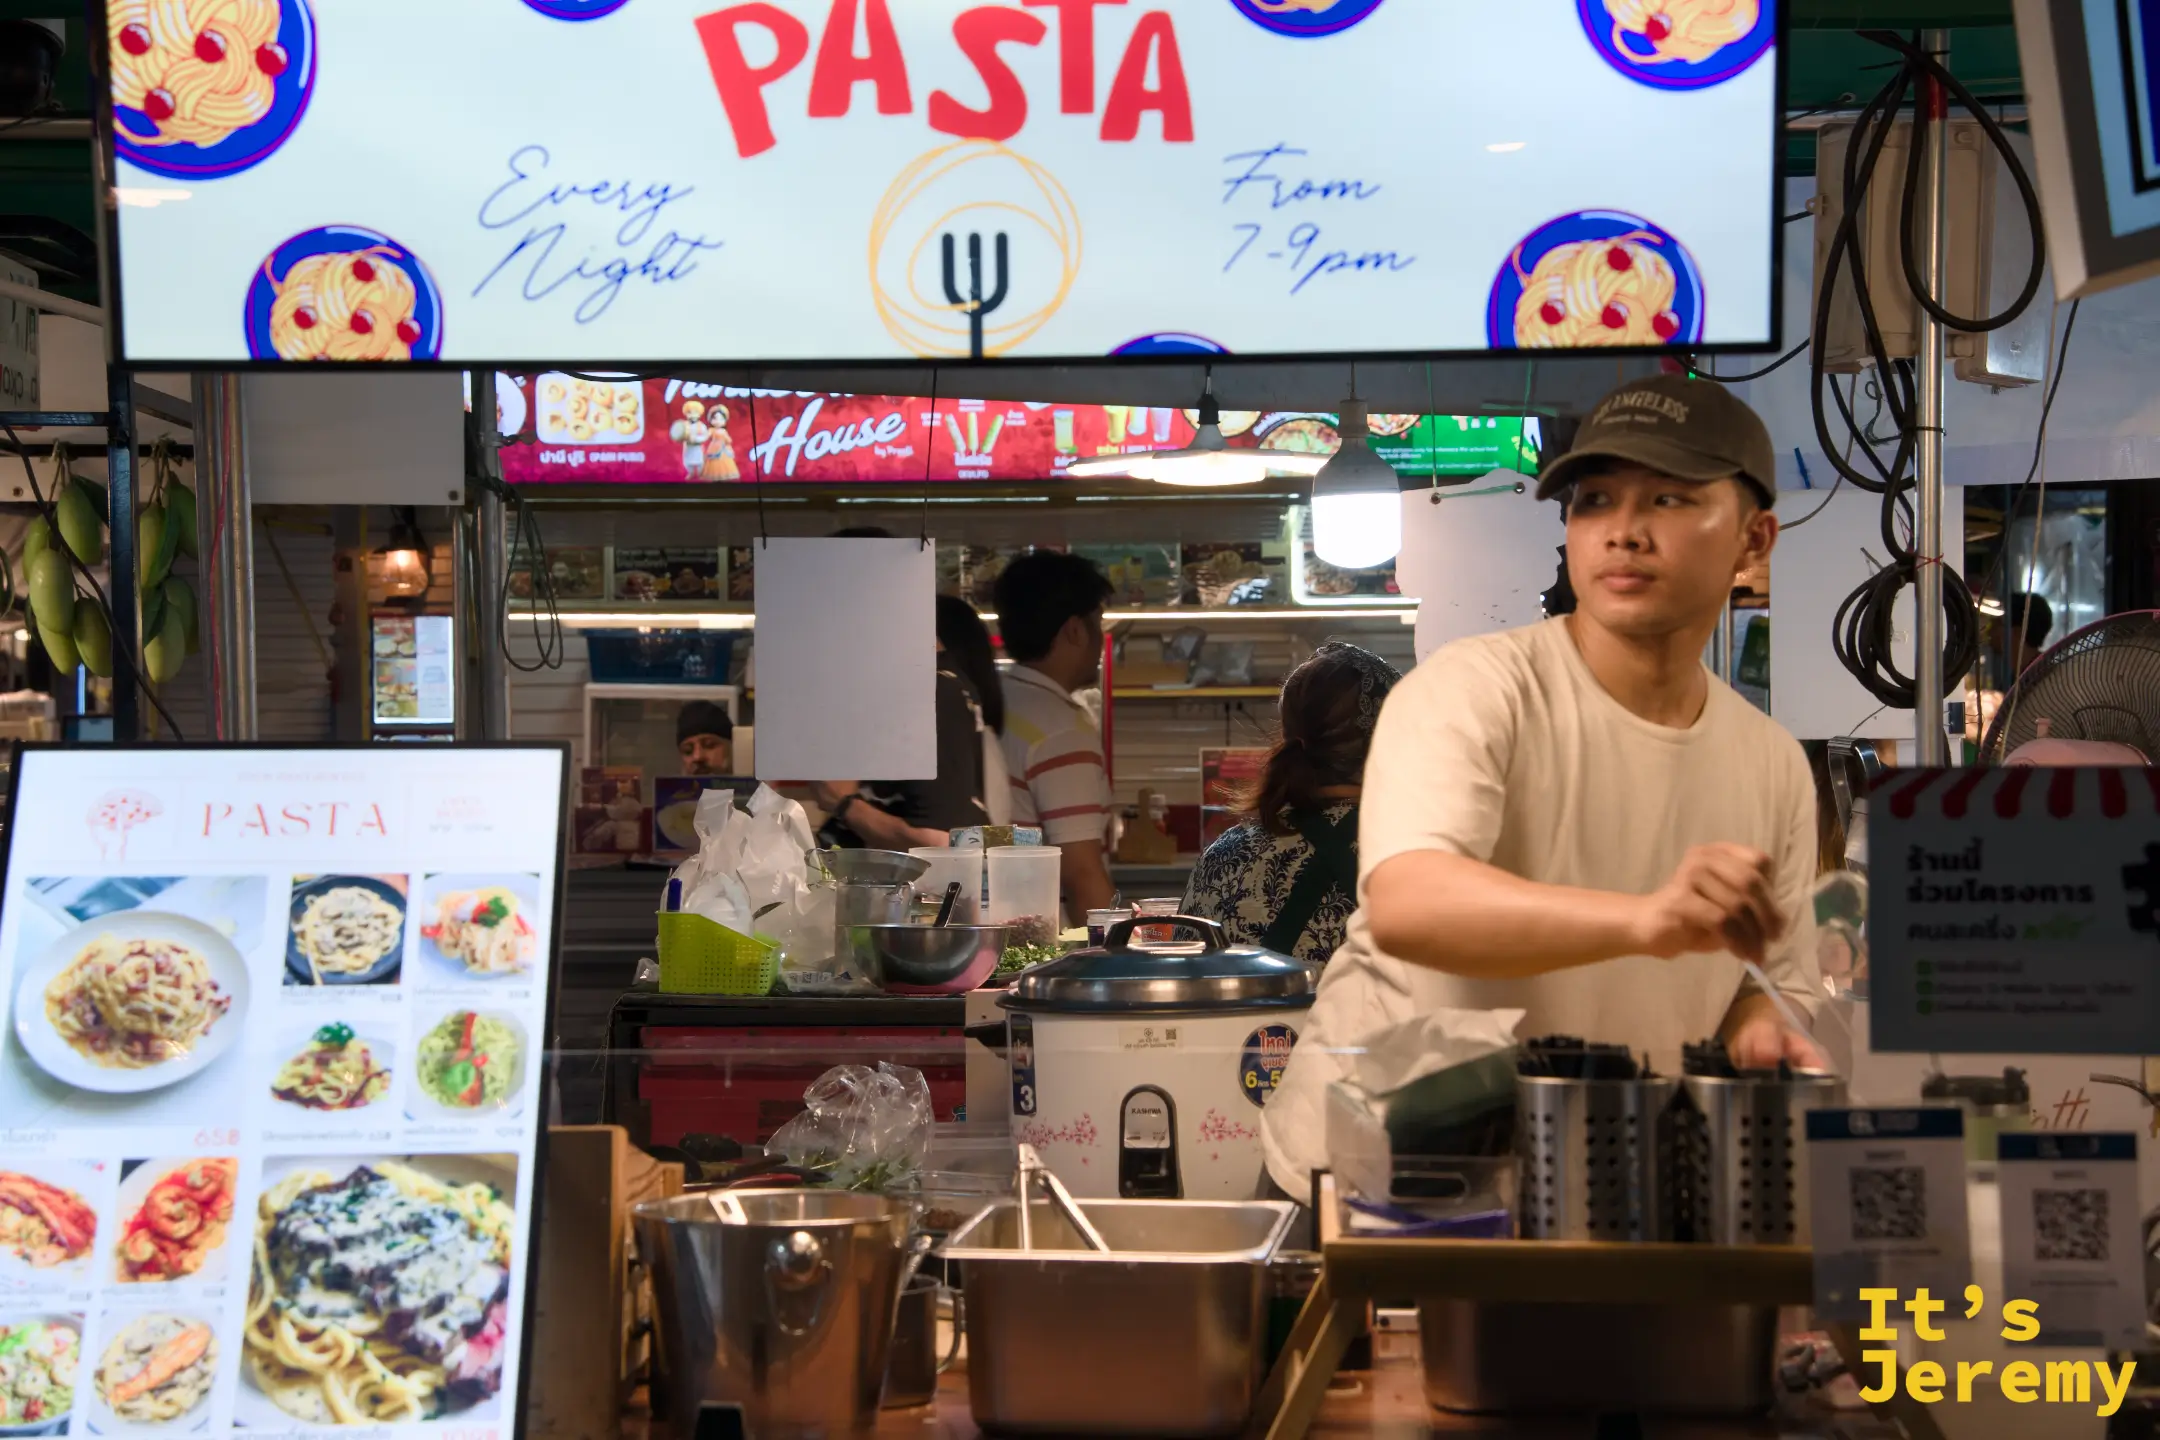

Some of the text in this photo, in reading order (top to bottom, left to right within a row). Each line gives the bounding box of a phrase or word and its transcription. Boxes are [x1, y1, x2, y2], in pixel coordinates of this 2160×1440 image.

[694, 0, 1195, 159] PASTA
[478, 145, 698, 248] Every
[1223, 142, 1380, 210] From
[471, 223, 723, 325] Night
[1221, 222, 1417, 296] 7-9pm
[750, 398, 906, 477] House
[200, 800, 390, 838] PASTA
[1131, 1107, 1162, 1115] KASHIWA
[1245, 1070, 1258, 1089] 6
